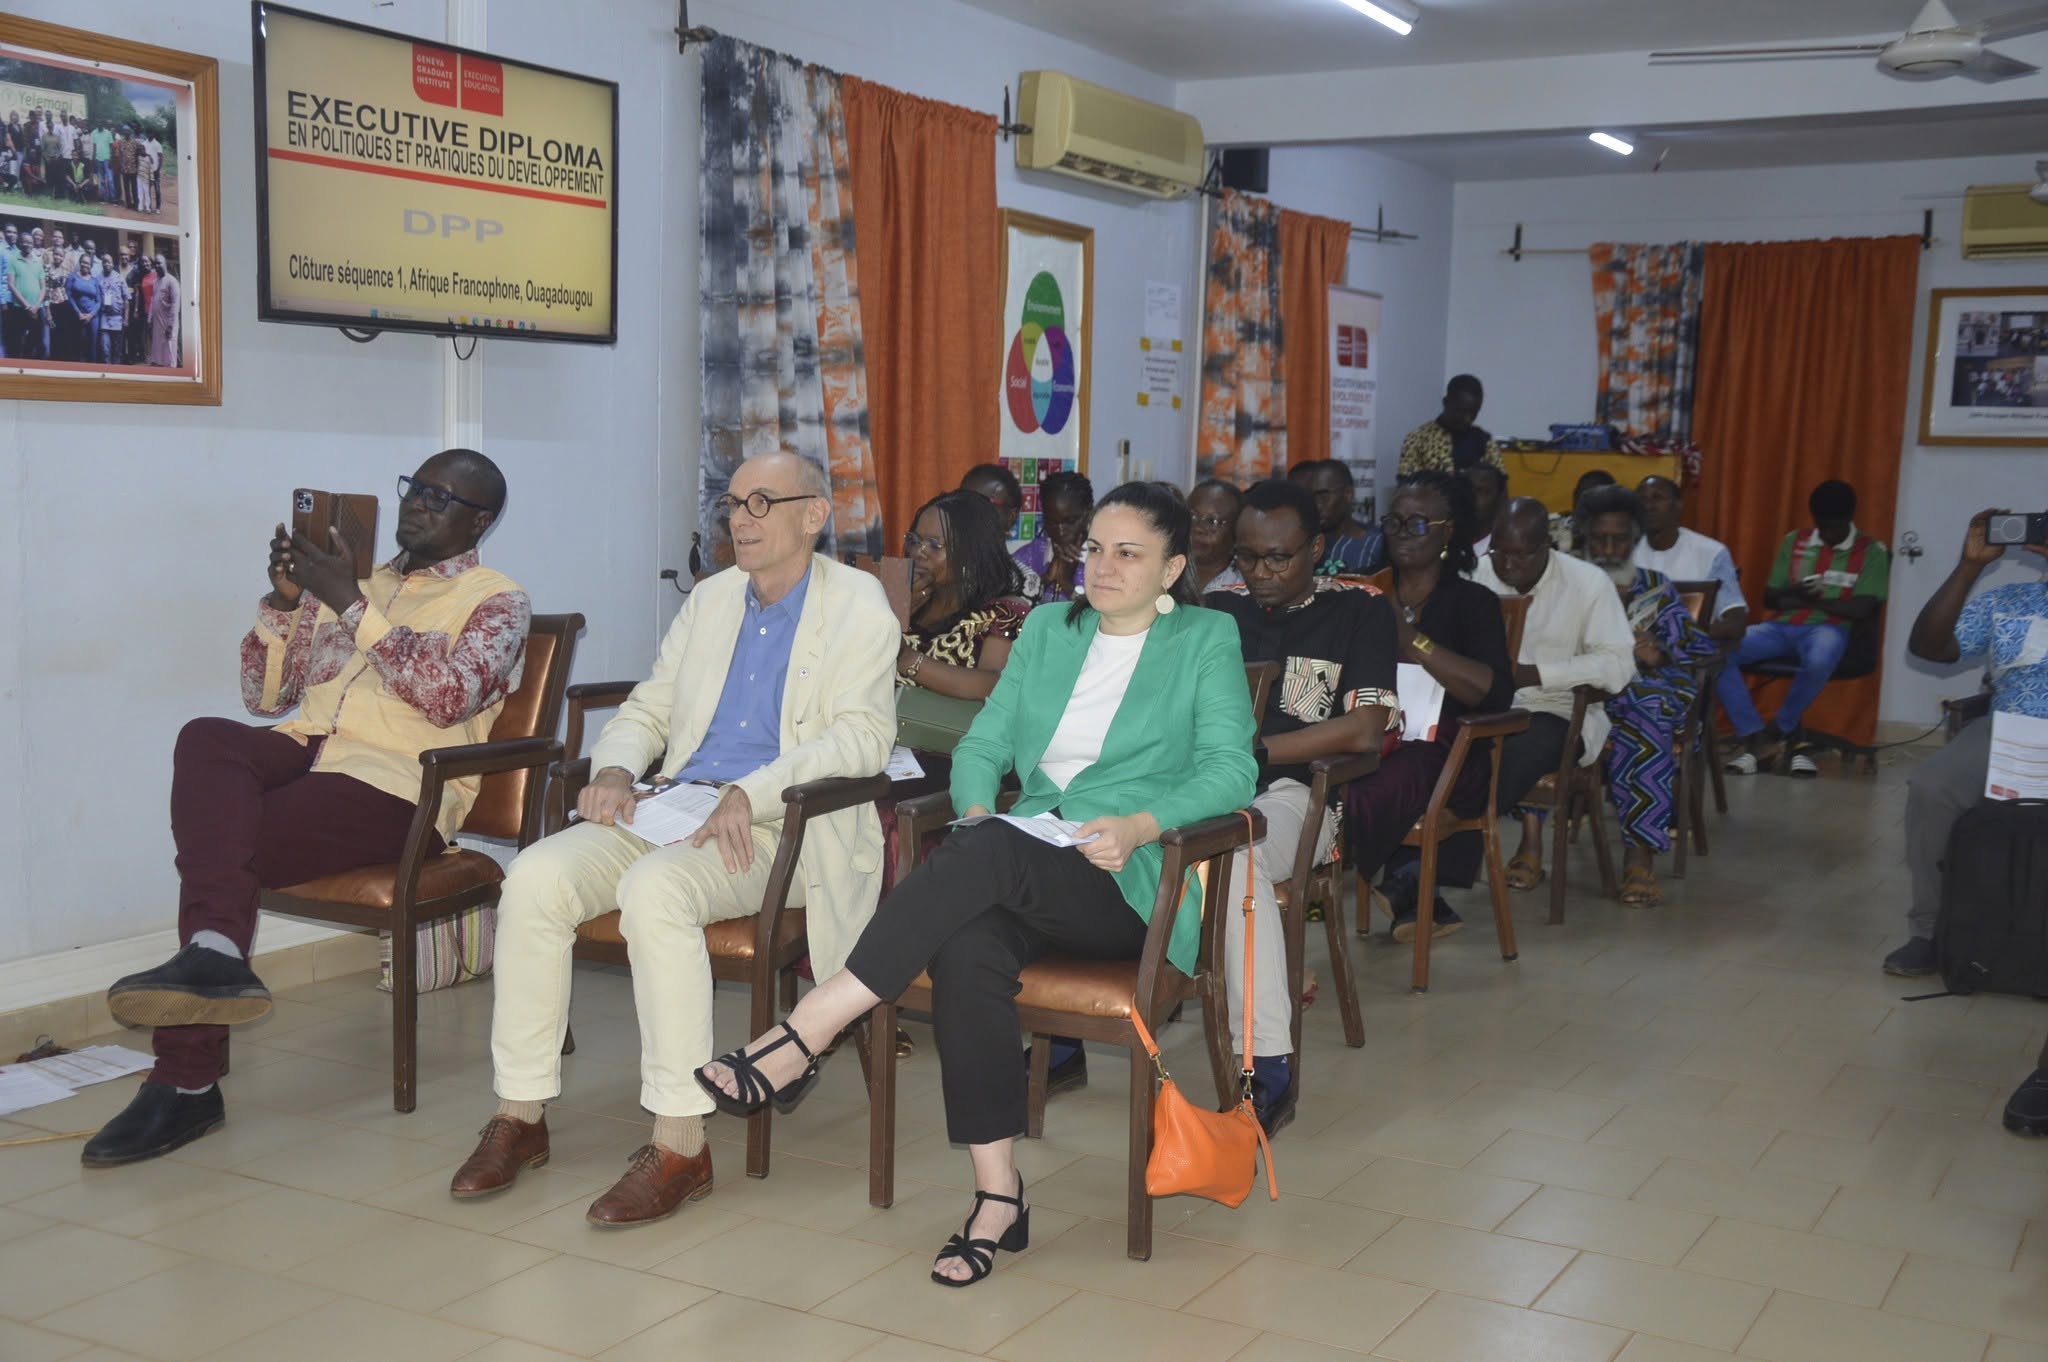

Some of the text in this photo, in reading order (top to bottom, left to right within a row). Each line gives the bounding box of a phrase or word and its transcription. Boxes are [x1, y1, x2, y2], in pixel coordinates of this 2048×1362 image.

[416, 54, 445, 67] GENEVA
[416, 65, 453, 80] GRADUATE
[463, 69, 497, 84] EXECUTIVE
[416, 76, 451, 90] INSTITUTE
[463, 79, 500, 94] EDUCATION
[288, 90, 604, 171] EXECUTIVE DIPLOMA
[288, 120, 604, 195] EN POLITIQUES ET PRATIQUES DU DEVELOPPEMENT
[402, 208, 504, 242] DPP
[289, 254, 593, 312] Clôture séquence 1, Afrique Francophone, Ouagadougou
